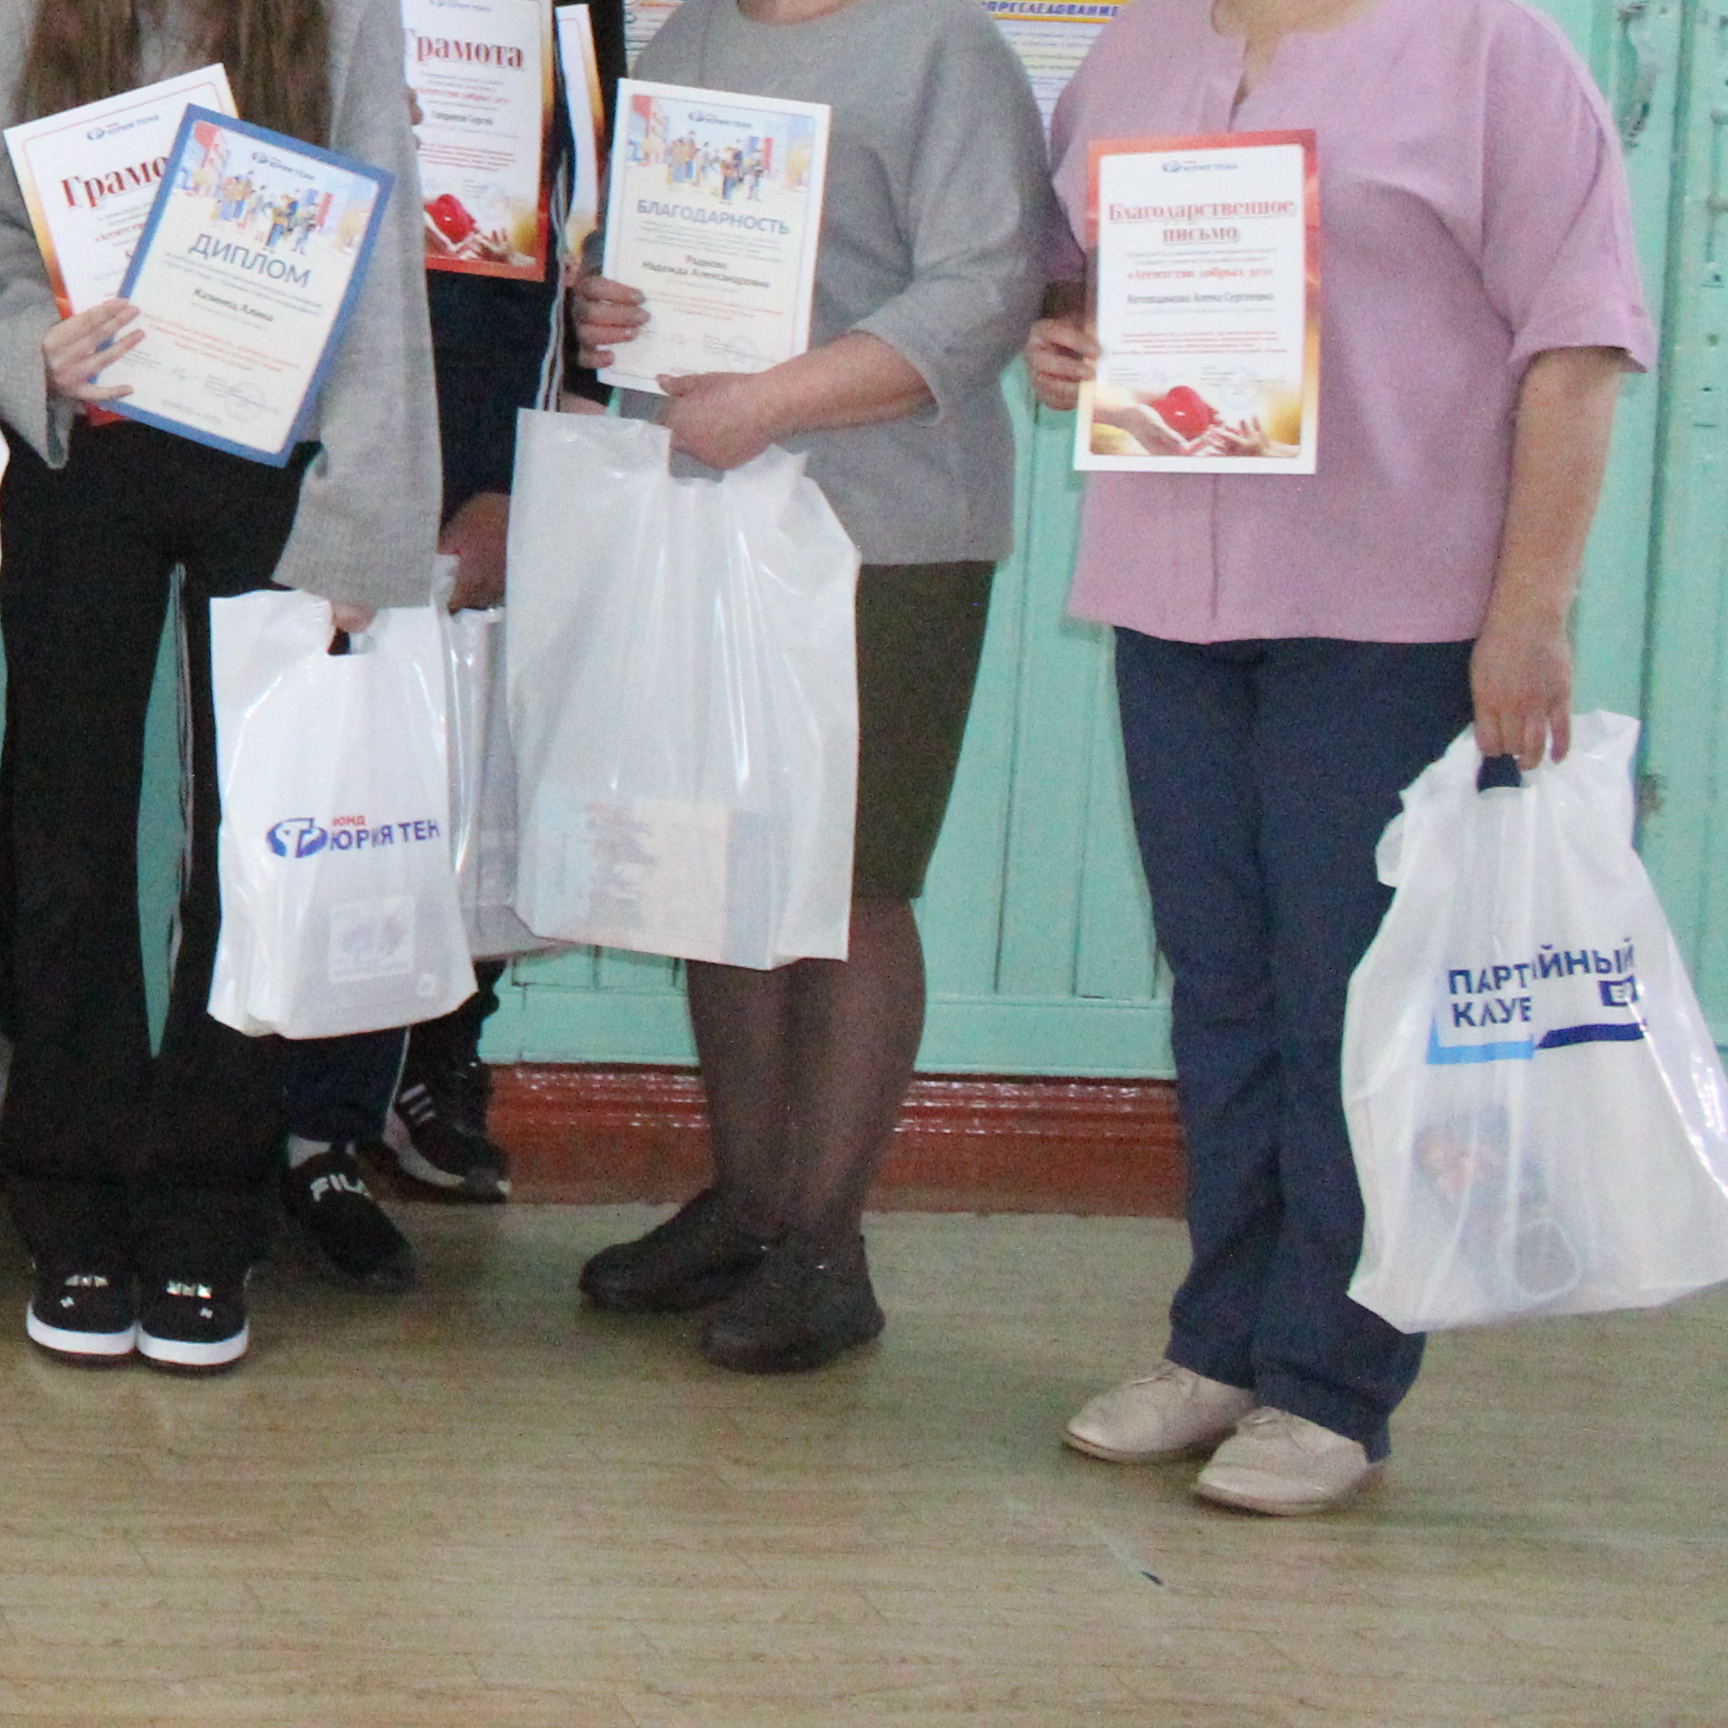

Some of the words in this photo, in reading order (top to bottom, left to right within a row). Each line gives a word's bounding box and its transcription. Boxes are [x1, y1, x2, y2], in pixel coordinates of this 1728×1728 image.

[636, 198, 791, 236] БЛАГОДАРНОСТЬ
[1109, 200, 1296, 223] Благодарственное
[1162, 227, 1239, 244] письмо
[188, 232, 312, 289] ДИПЛОМ
[330, 825, 395, 852] ЮРИЯ
